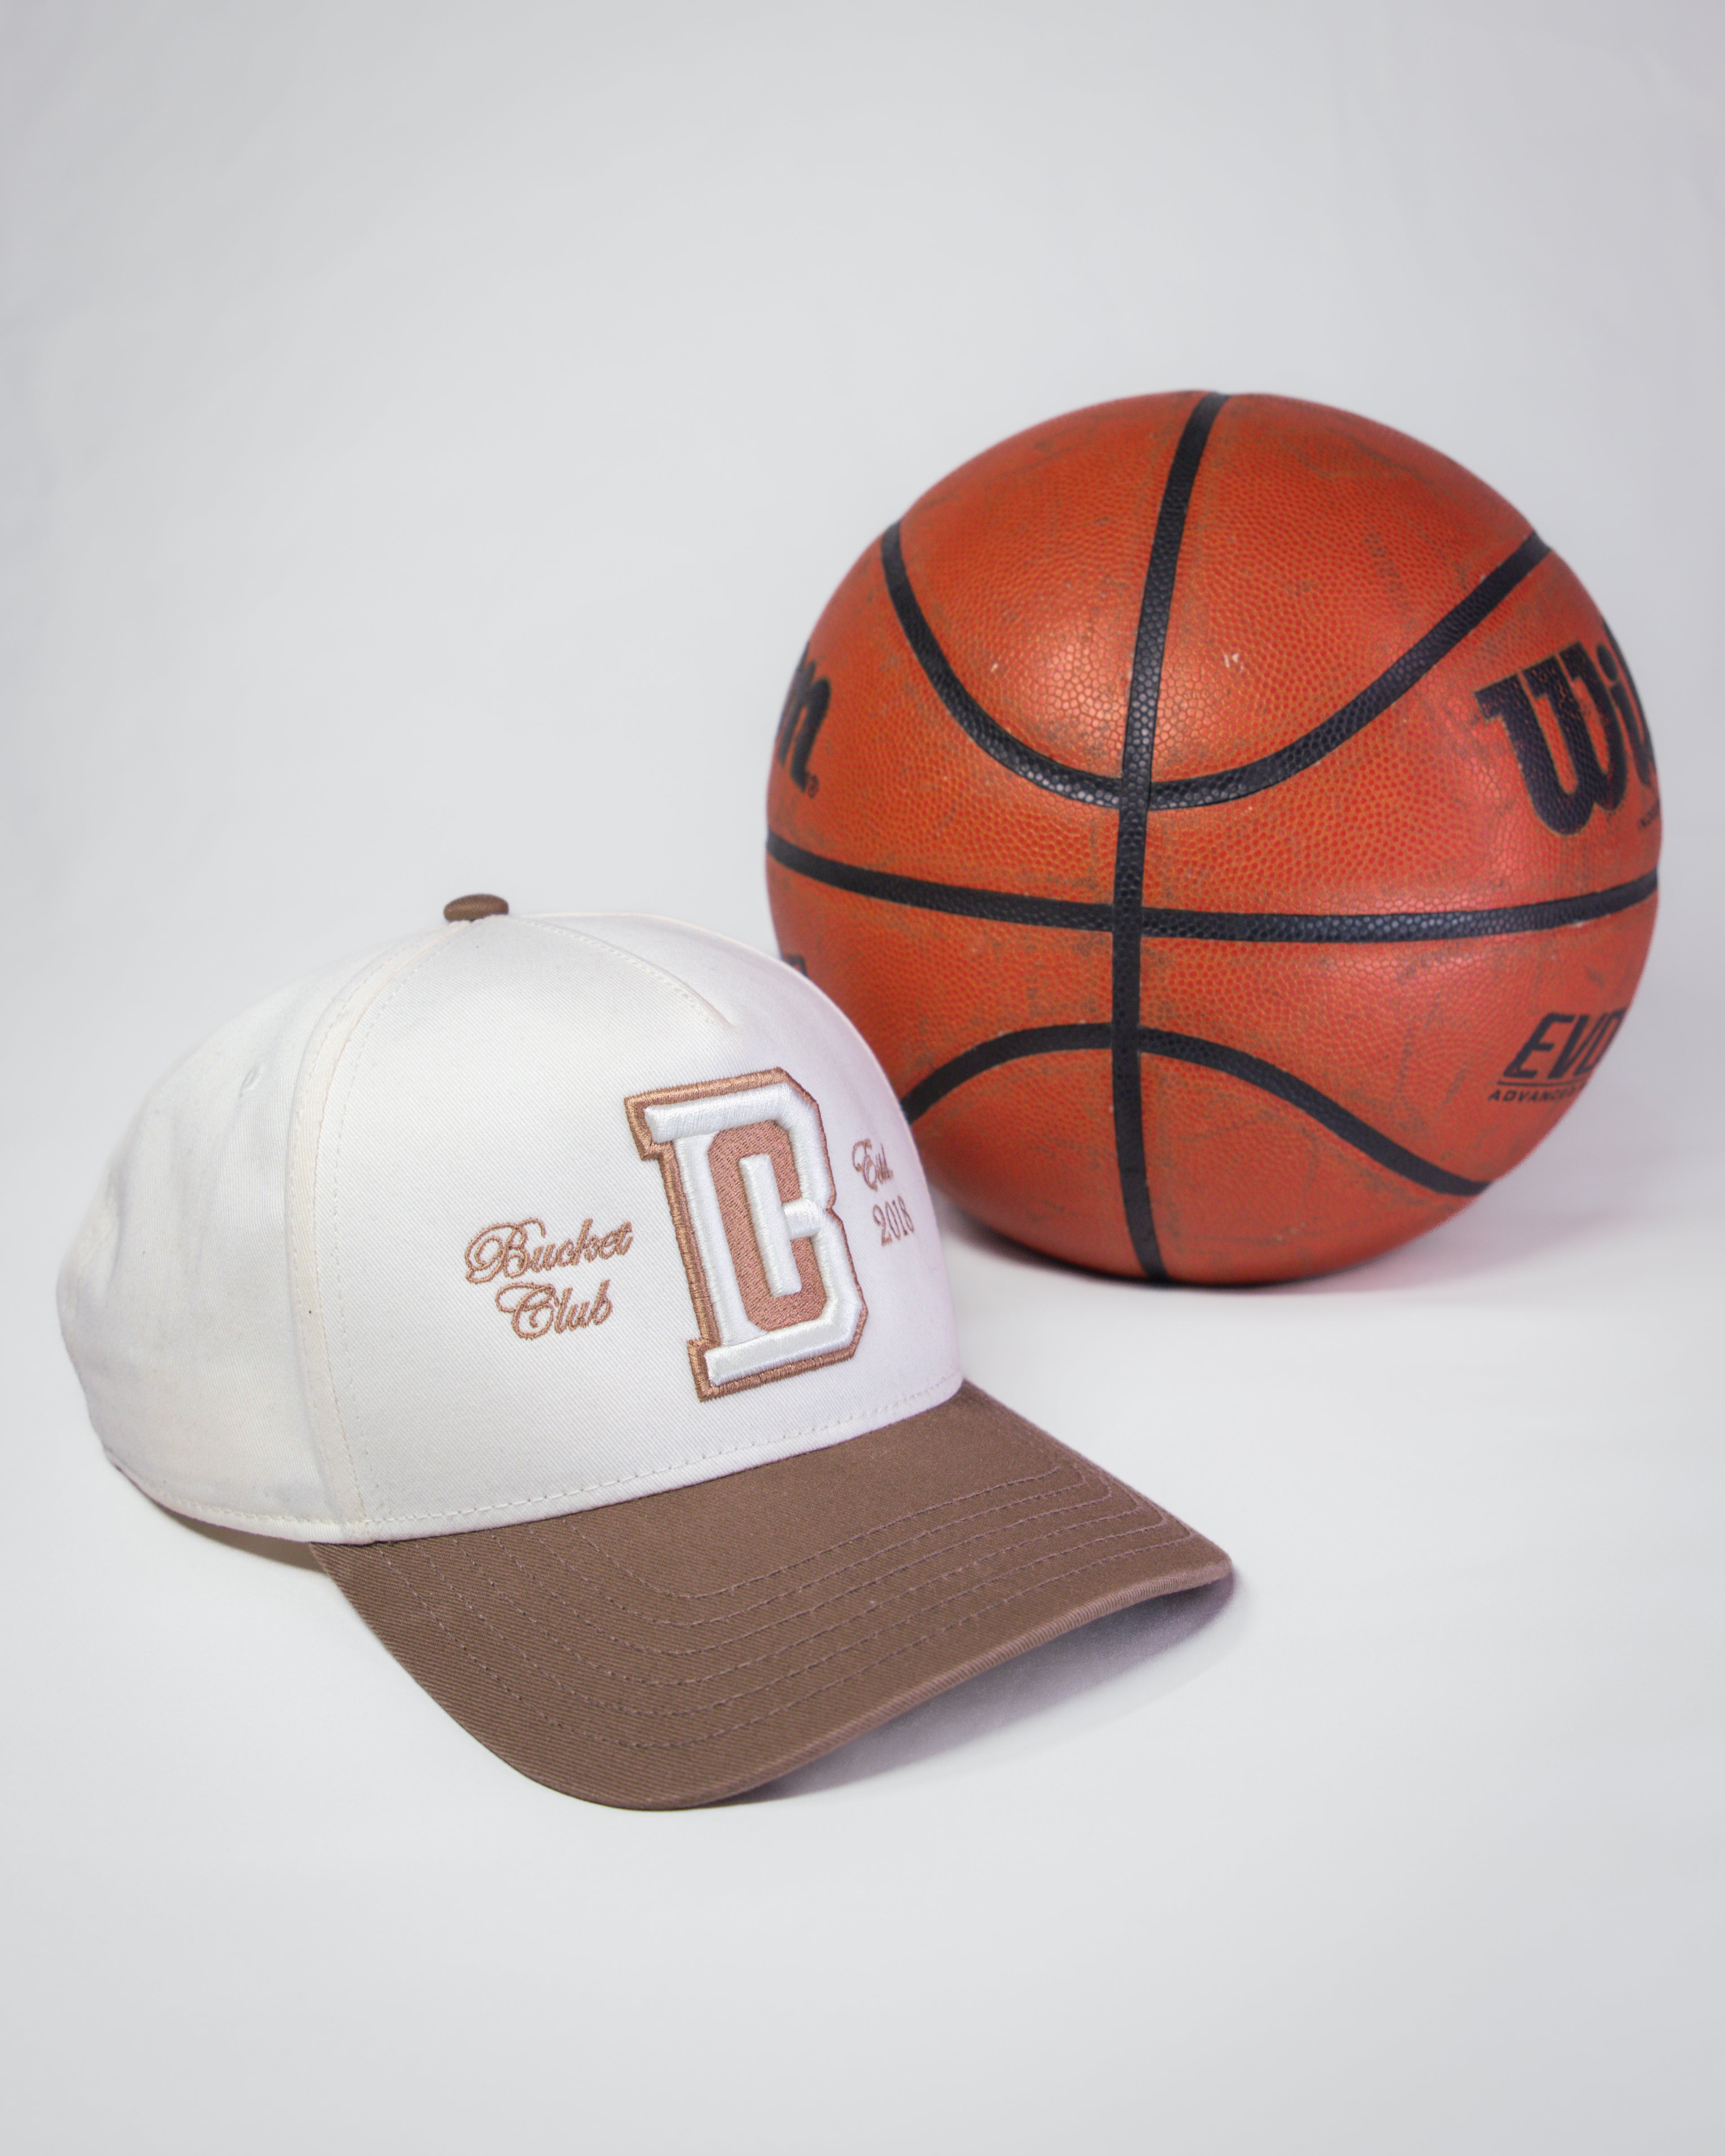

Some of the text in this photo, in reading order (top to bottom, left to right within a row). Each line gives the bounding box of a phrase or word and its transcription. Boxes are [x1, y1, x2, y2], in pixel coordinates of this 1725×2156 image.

[464, 1217, 633, 1284] Bucket
[872, 1195, 915, 1246] 2018
[495, 1279, 613, 1340] Club
